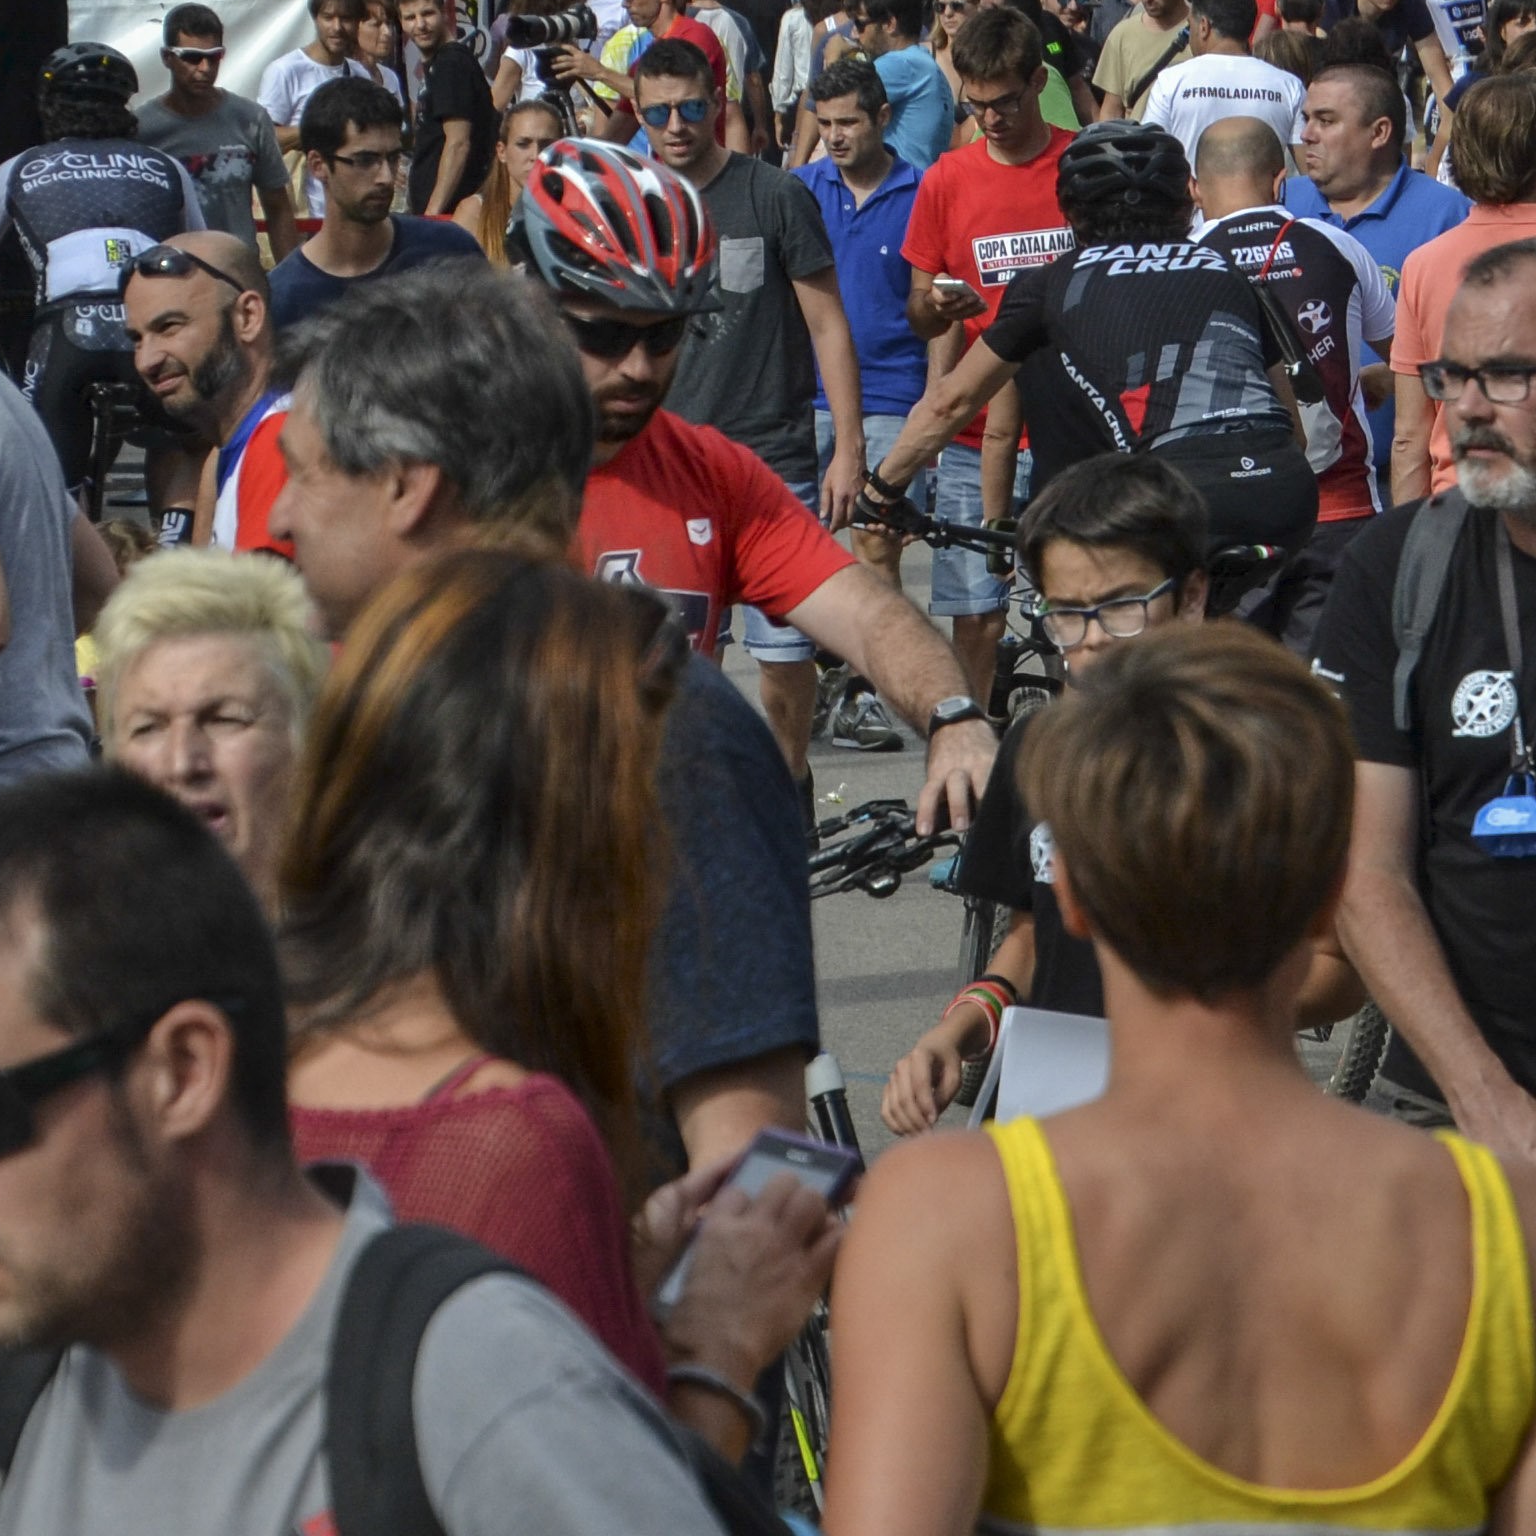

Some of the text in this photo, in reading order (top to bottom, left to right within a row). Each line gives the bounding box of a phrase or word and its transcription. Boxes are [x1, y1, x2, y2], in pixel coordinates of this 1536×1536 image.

[1181, 85, 1283, 105] #FRMGLADIATOR
[22, 168, 171, 194] BICICLINIC.COM
[1227, 221, 1281, 235] SURAL
[978, 230, 1075, 261] COPA CATALANA
[1073, 243, 1224, 270] SANTA
[1107, 258, 1229, 277] CRUZ
[1061, 352, 1107, 413] SANTA
